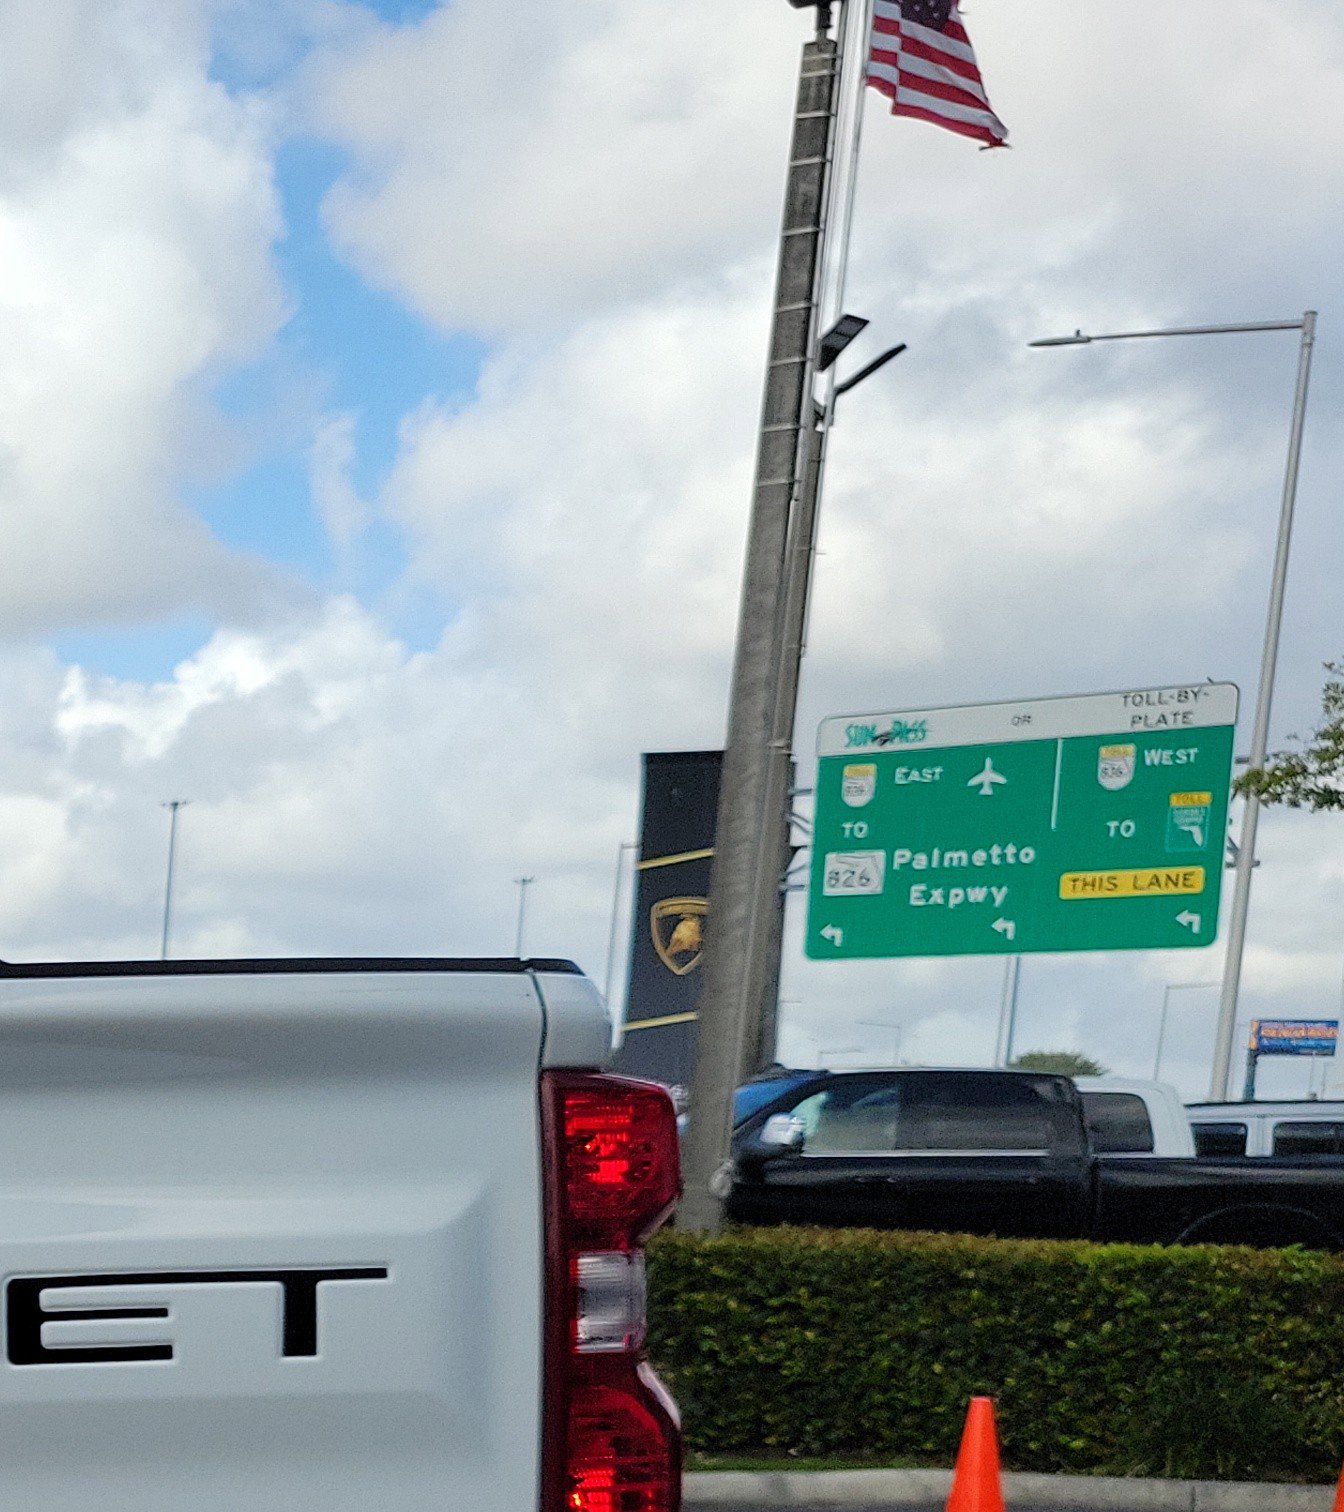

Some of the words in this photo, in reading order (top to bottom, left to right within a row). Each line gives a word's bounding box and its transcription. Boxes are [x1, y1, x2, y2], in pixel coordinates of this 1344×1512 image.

[1130, 711, 1194, 729] PLATE
[1143, 747, 1199, 767] WEST
[894, 766, 945, 785] EAST
[841, 821, 869, 839] TO
[1105, 819, 1136, 838] TO
[892, 842, 1036, 871] Palmetto
[827, 868, 871, 888] 826
[1070, 875, 1119, 893] THIS
[1132, 870, 1196, 891] LANE
[909, 883, 1009, 909] Expwy
